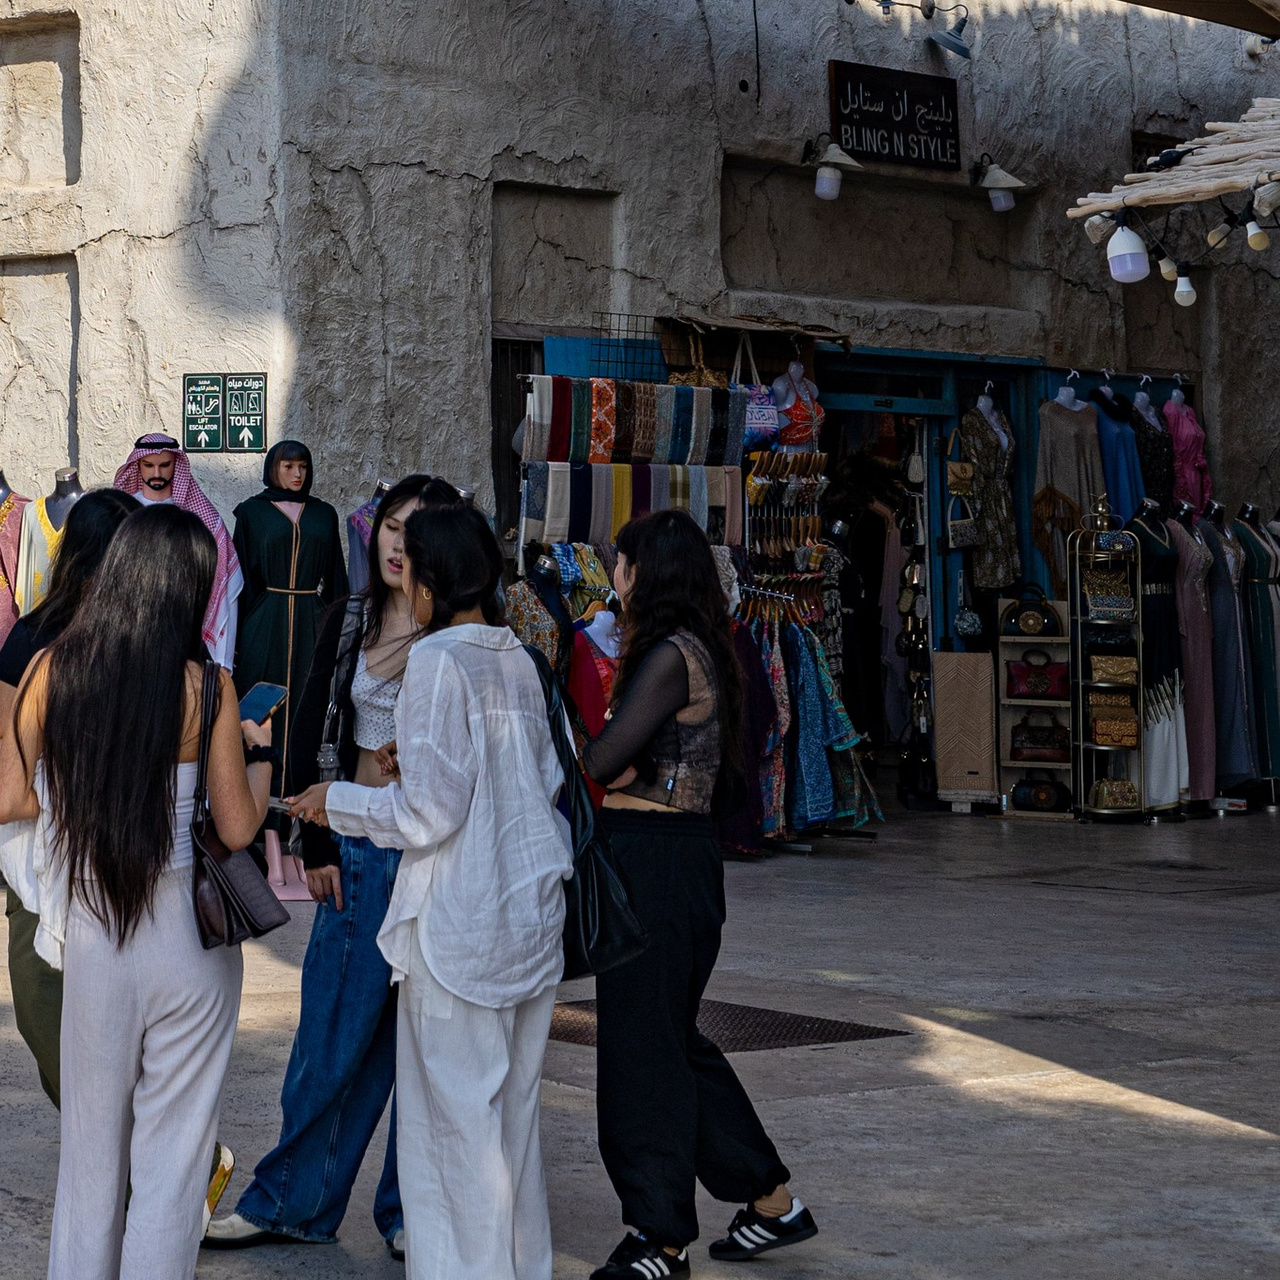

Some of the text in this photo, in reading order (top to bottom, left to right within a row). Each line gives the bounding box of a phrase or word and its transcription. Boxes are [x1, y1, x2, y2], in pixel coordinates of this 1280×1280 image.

[840, 81, 953, 134] بلينج ان ستايل
[841, 124, 957, 163] BLING N STYLE
[228, 378, 263, 390] دورات مياه
[229, 416, 262, 426] TOILET
